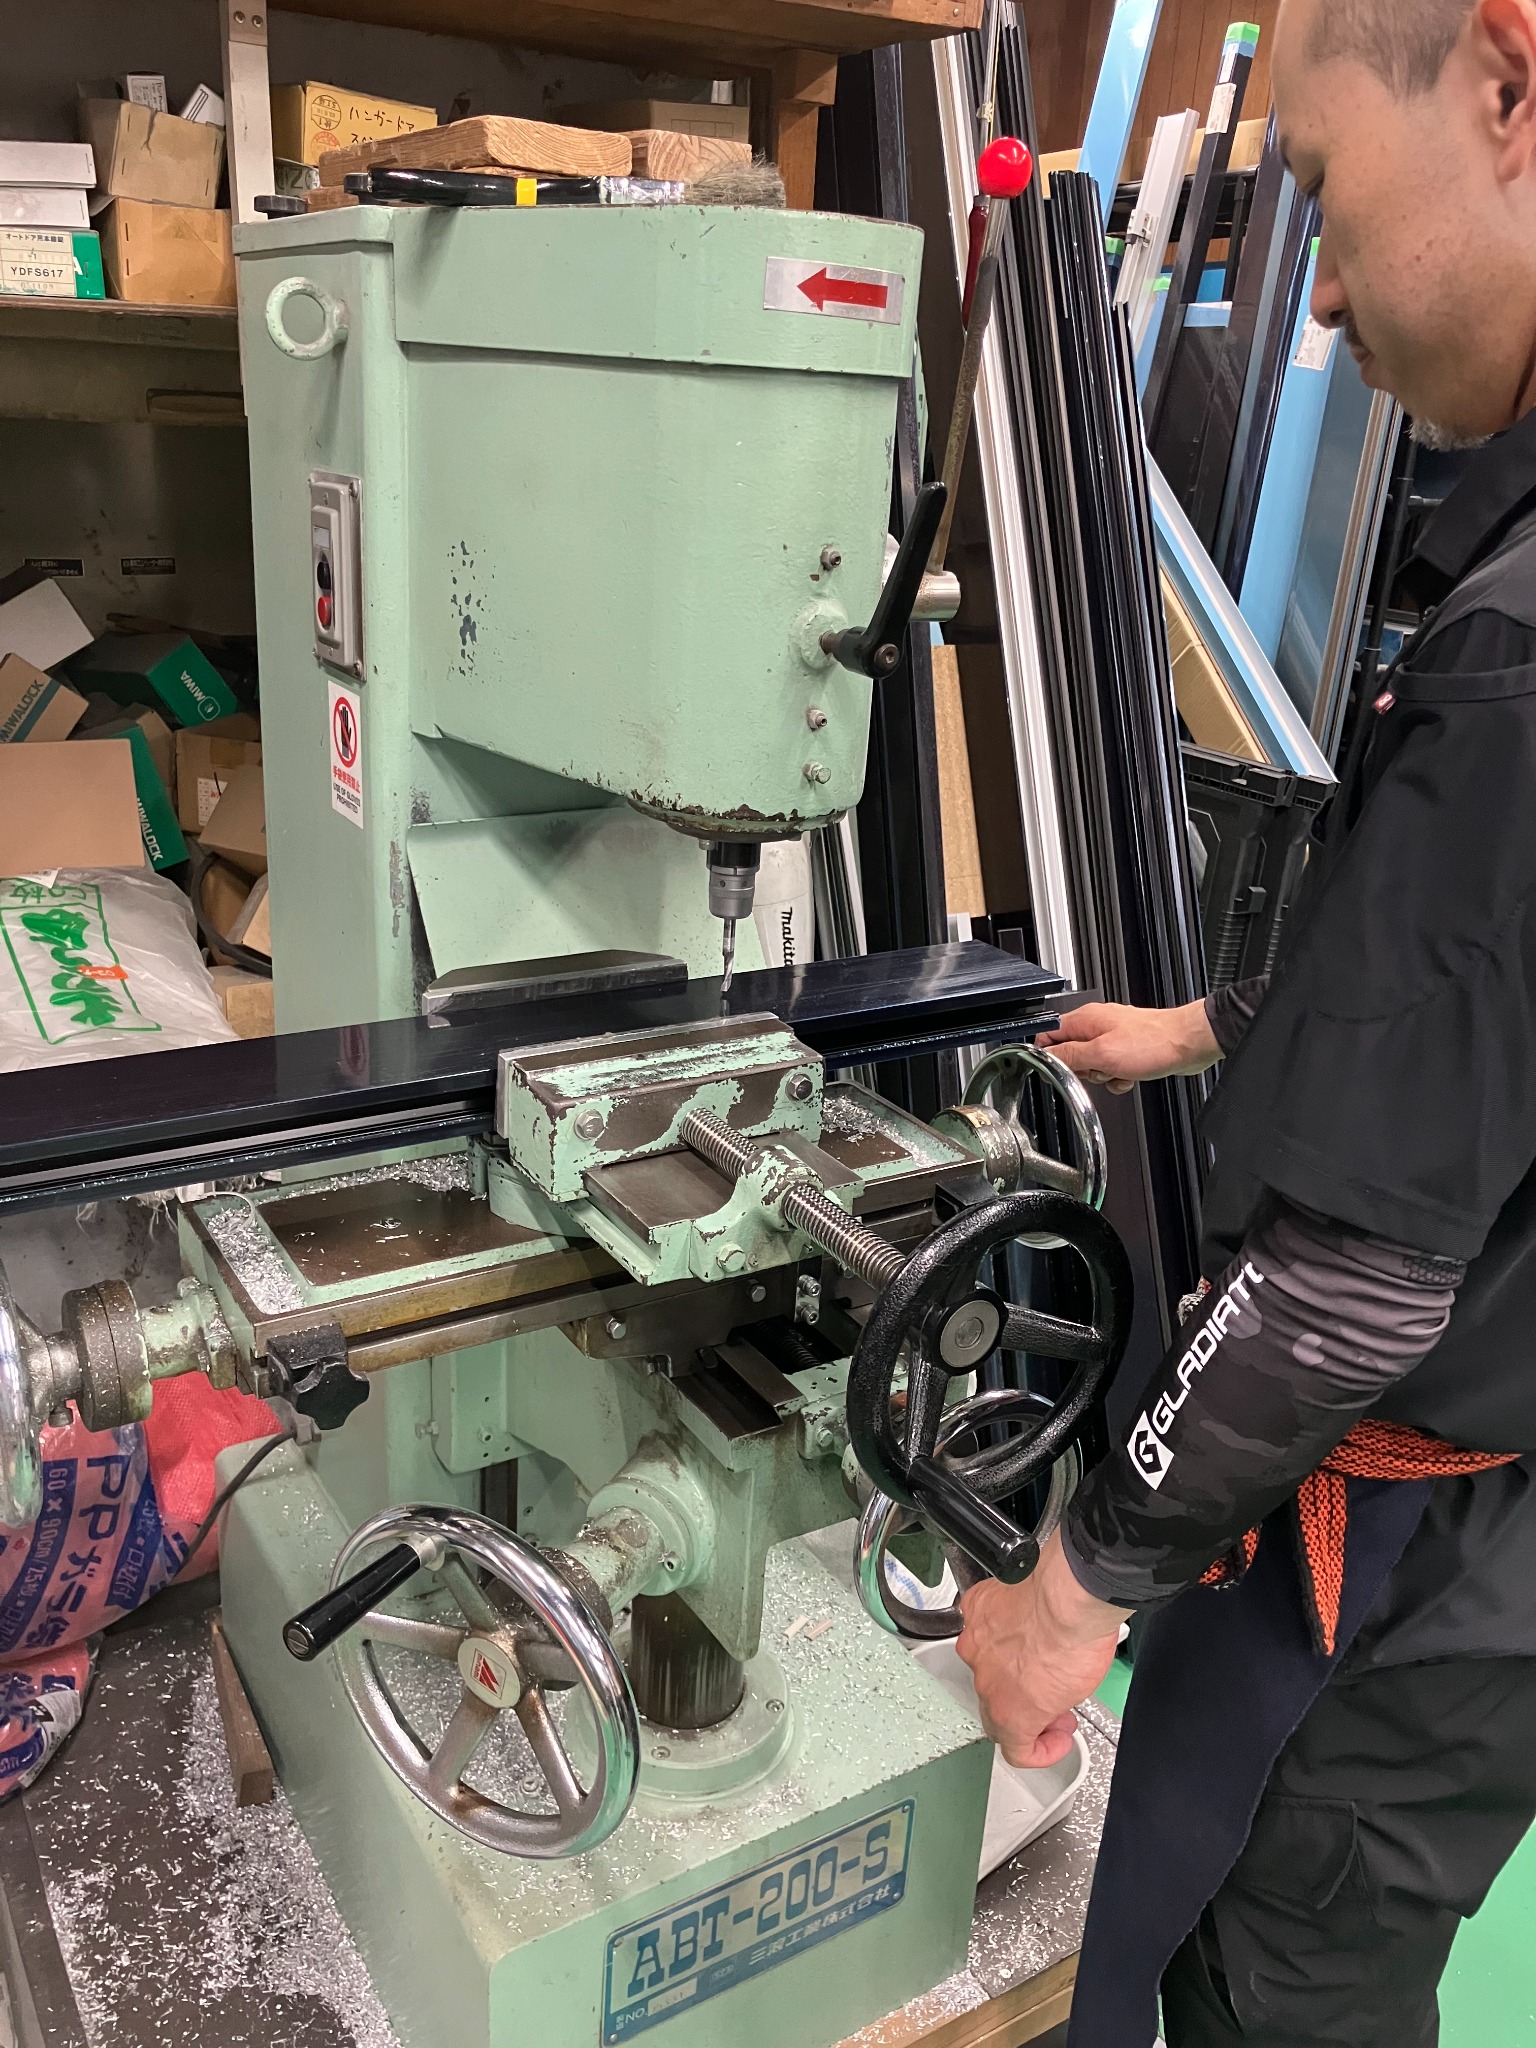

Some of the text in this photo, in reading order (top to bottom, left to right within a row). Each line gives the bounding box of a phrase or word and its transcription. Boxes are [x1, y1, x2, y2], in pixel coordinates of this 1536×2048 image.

[349, 106, 415, 132] ハンガードア
[11, 266, 64, 278] YDFS617
[180, 670, 206, 702] MIWA
[627, 1819, 892, 1998] ABT-200-S
[625, 2007, 648, 2024] NO.
